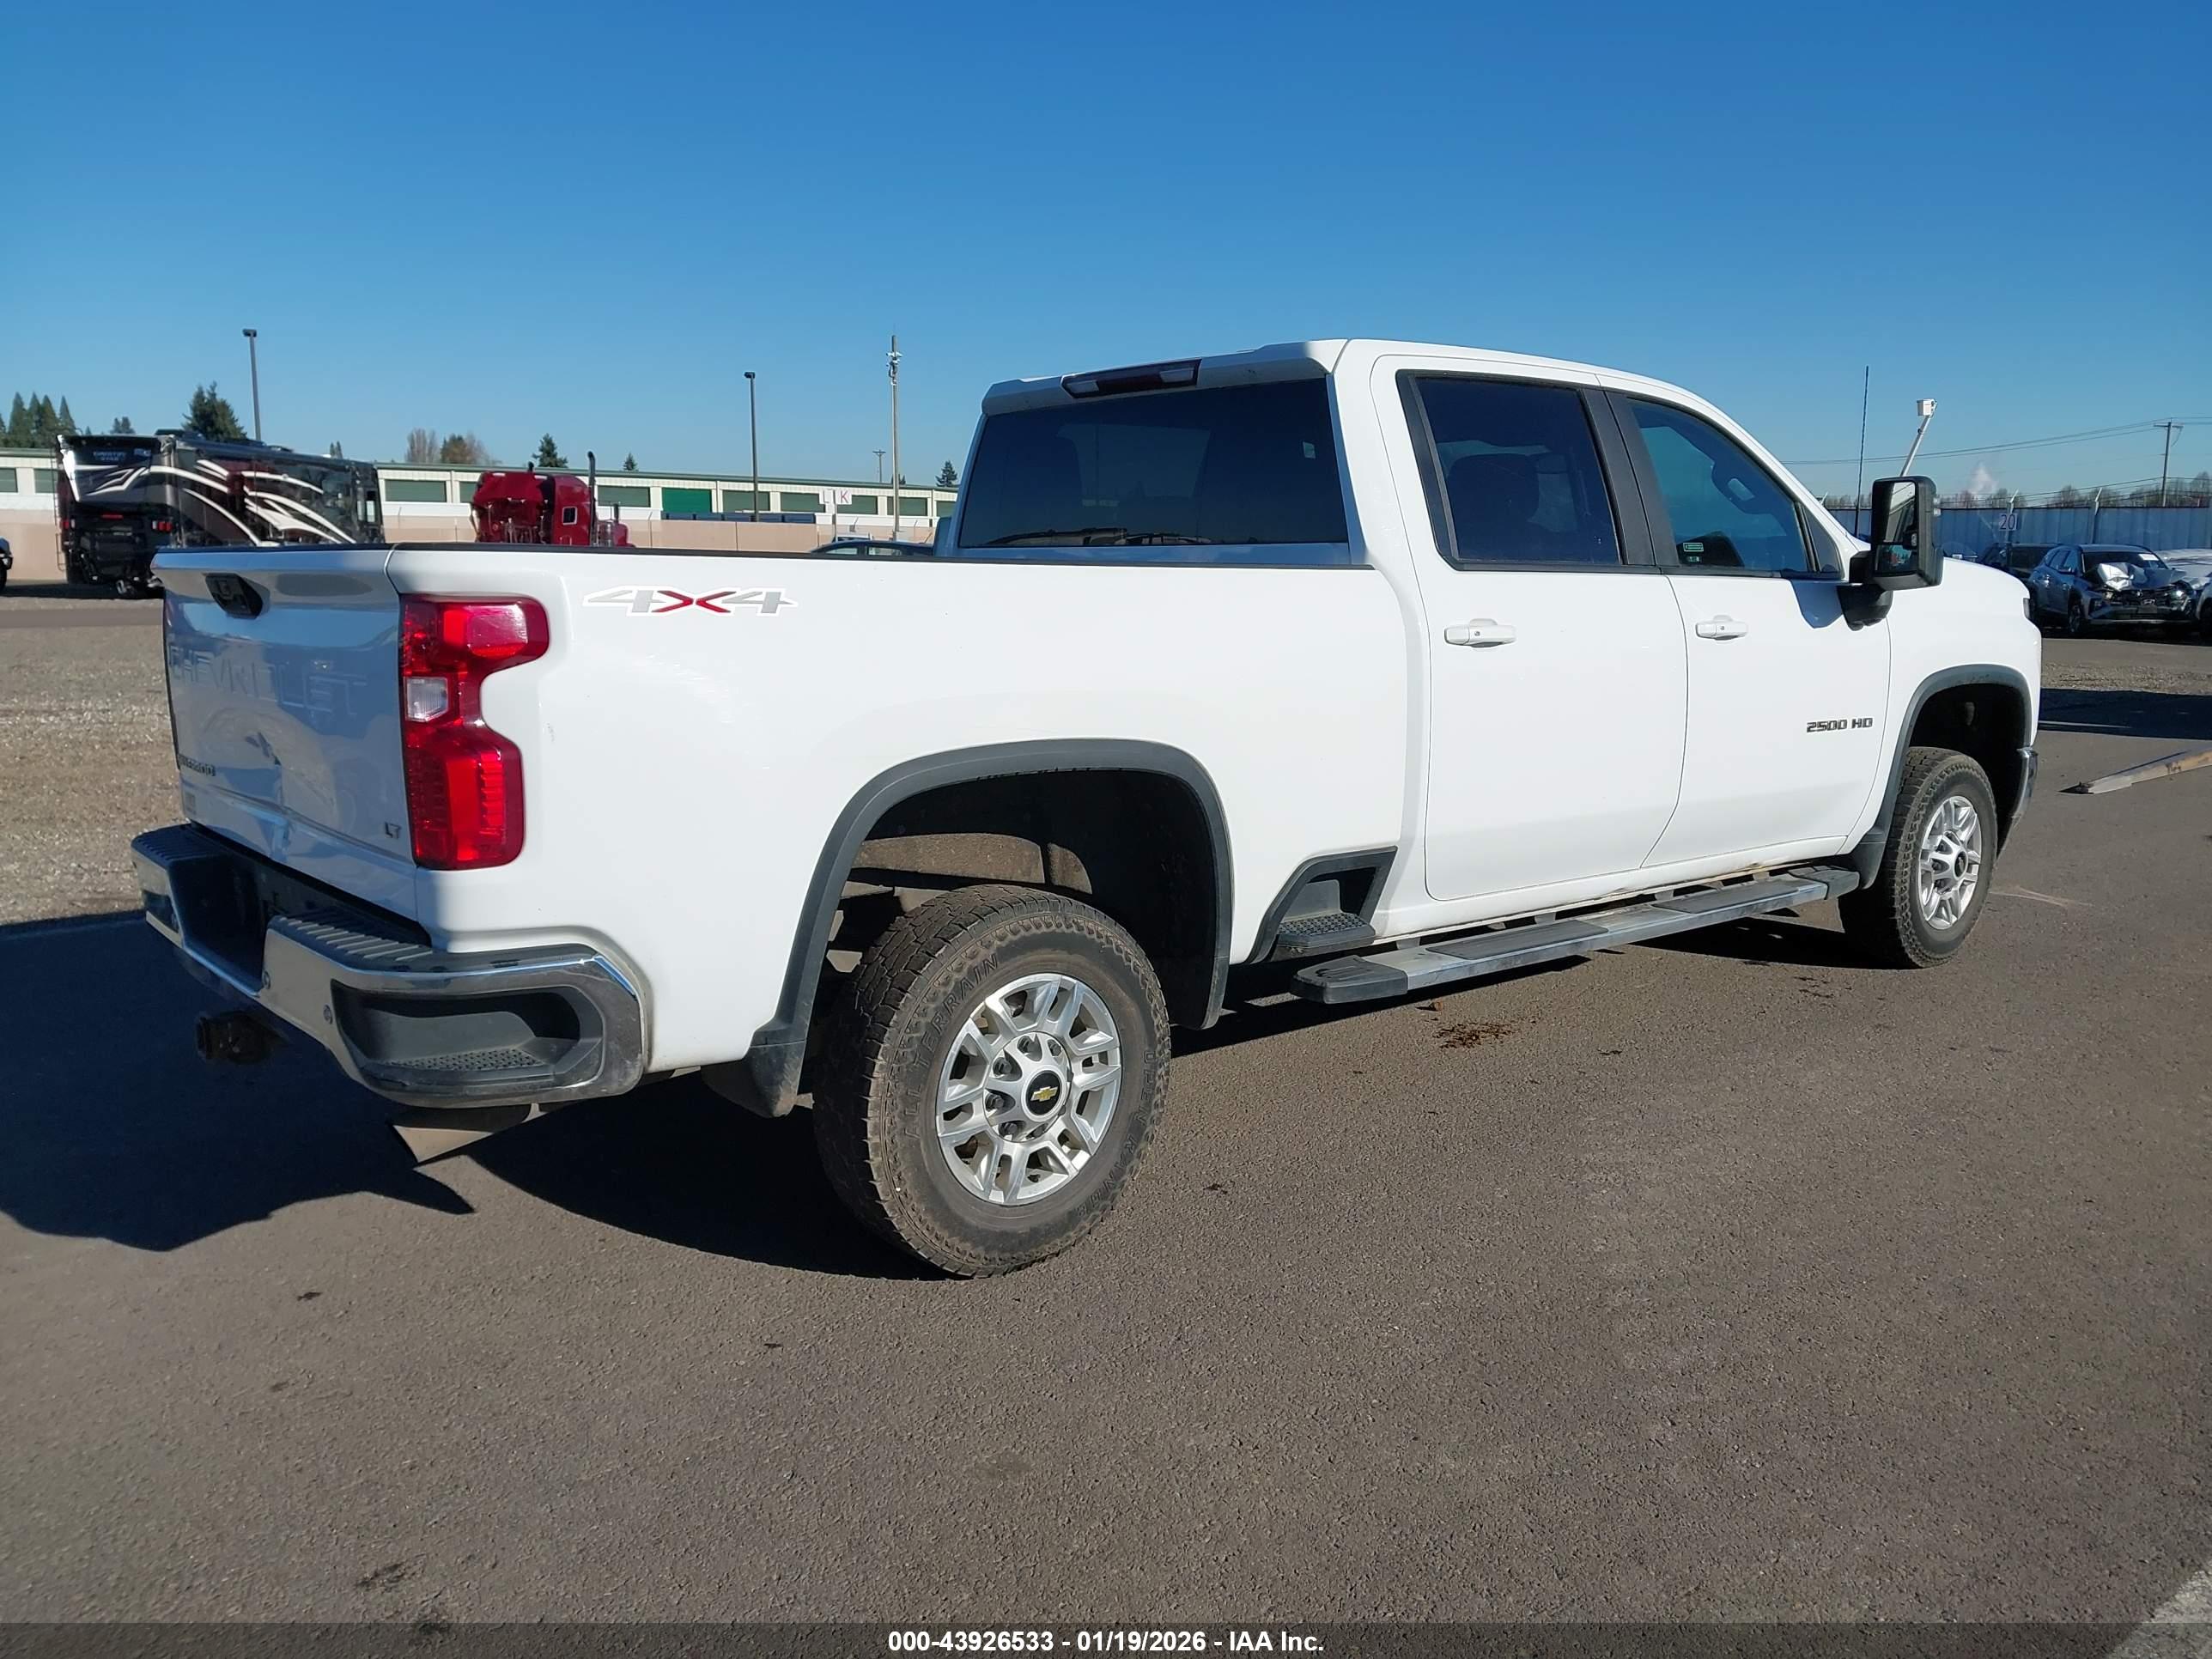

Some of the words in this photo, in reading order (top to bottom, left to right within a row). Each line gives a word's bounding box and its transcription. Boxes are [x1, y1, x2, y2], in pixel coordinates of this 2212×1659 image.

[841, 490, 849, 504] K
[2000, 514, 2015, 530] 20
[167, 646, 368, 716] CHEVROLET
[1806, 720, 1848, 733] 2500
[1851, 717, 1874, 729] HD
[384, 821, 402, 840] LT
[913, 953, 999, 1068] TERRAIN
[1133, 1050, 1156, 1126] OPEN
